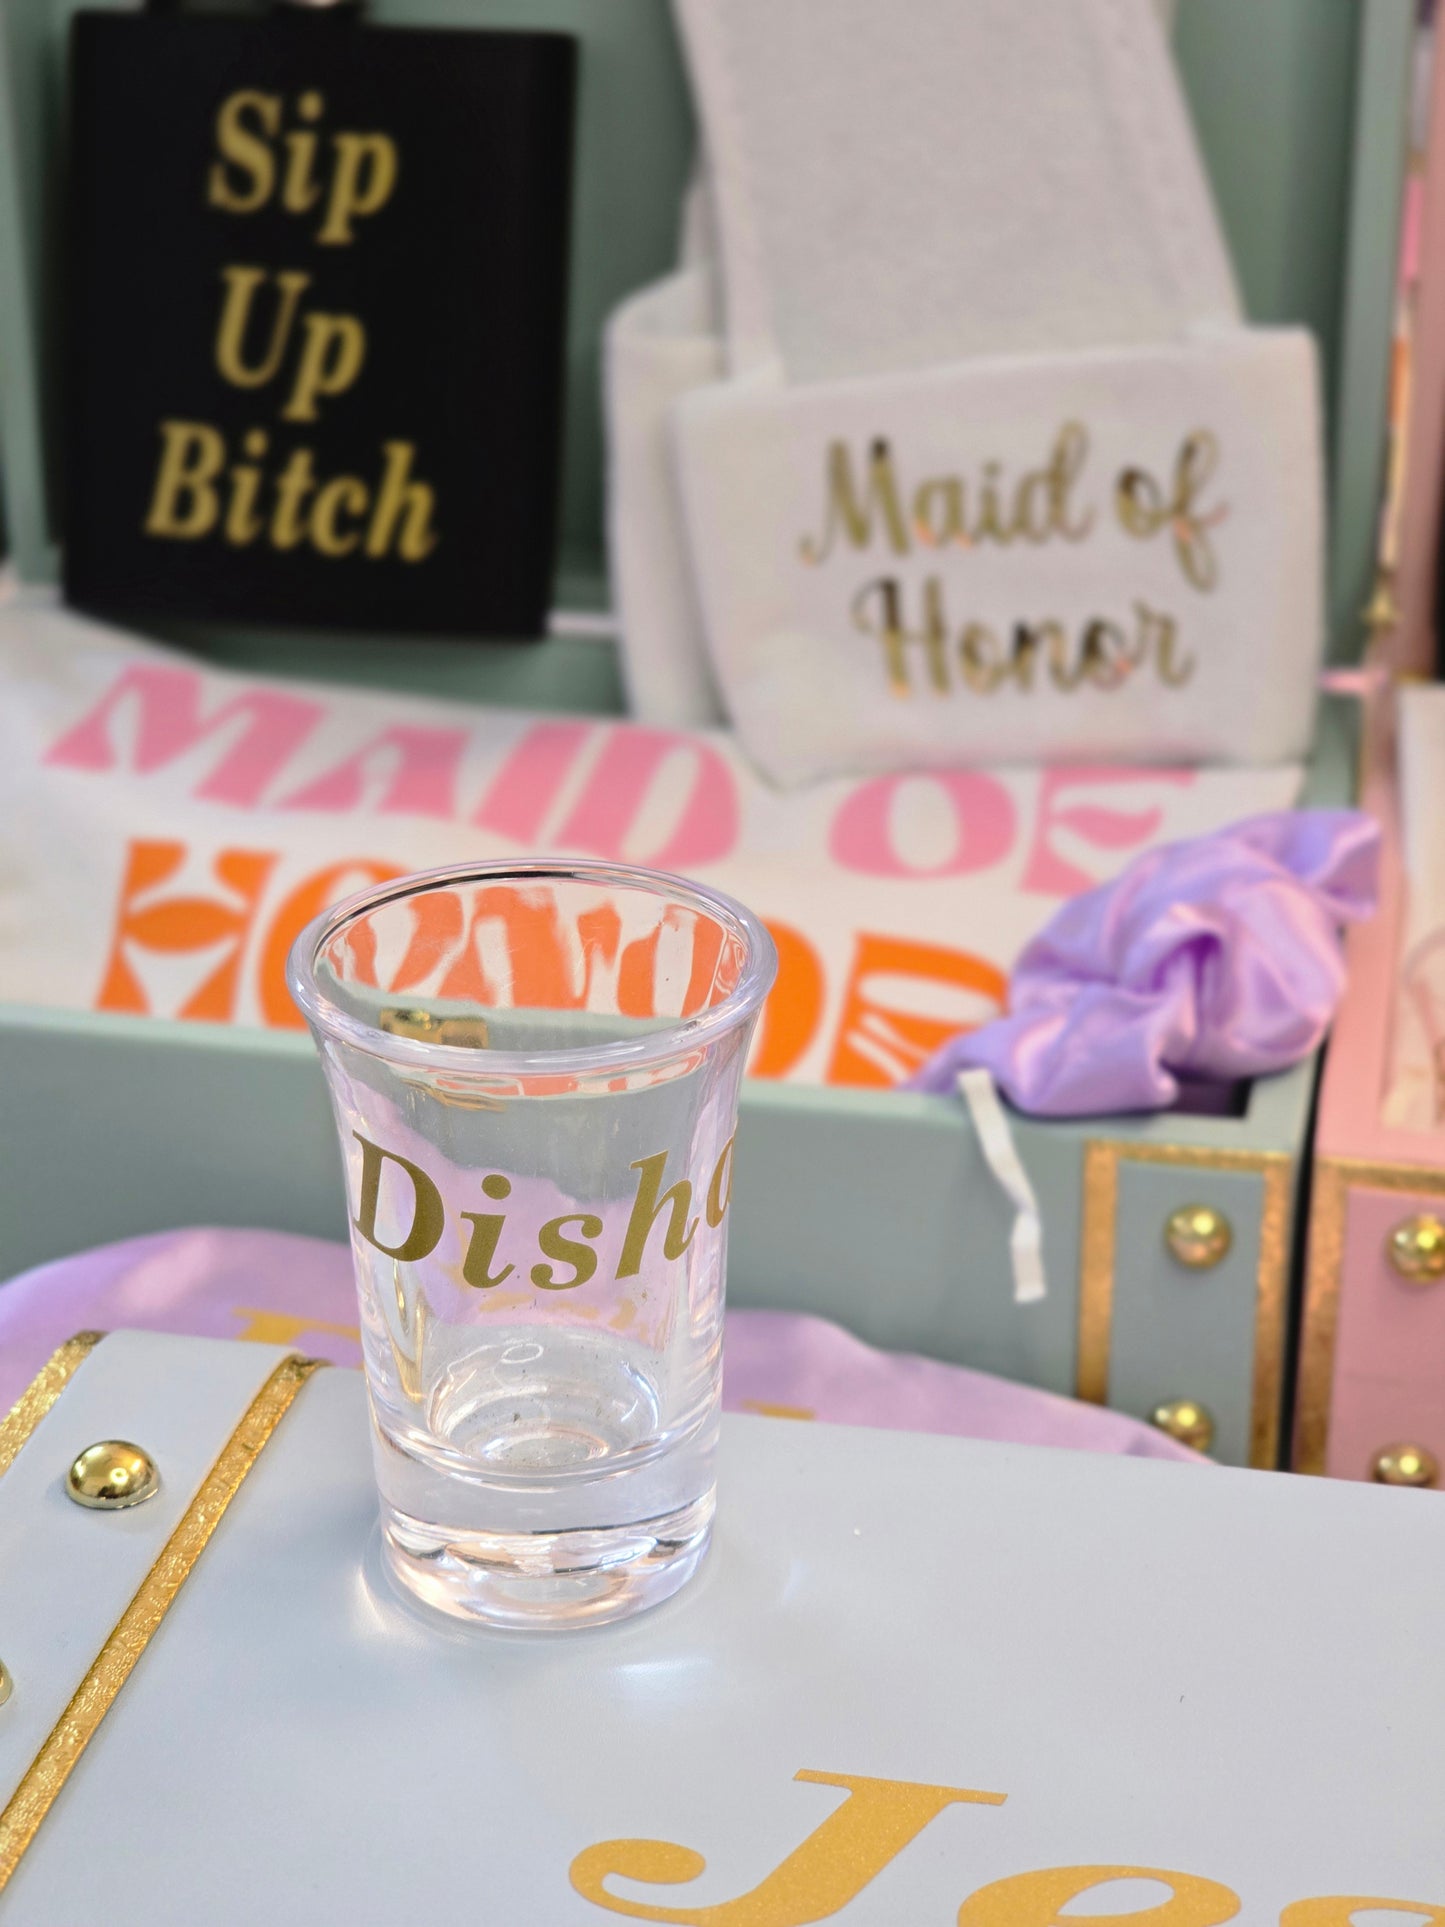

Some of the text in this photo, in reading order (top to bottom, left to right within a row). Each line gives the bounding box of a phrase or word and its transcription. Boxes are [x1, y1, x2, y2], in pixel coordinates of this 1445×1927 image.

[208, 89, 399, 245] Sip
[215, 265, 367, 422] Up
[144, 420, 438, 563] Bitch
[798, 418, 1229, 594] Maid of
[850, 575, 1196, 697] Honor
[41, 664, 1198, 898] MAID OF
[568, 1769, 1445, 1927] Je
